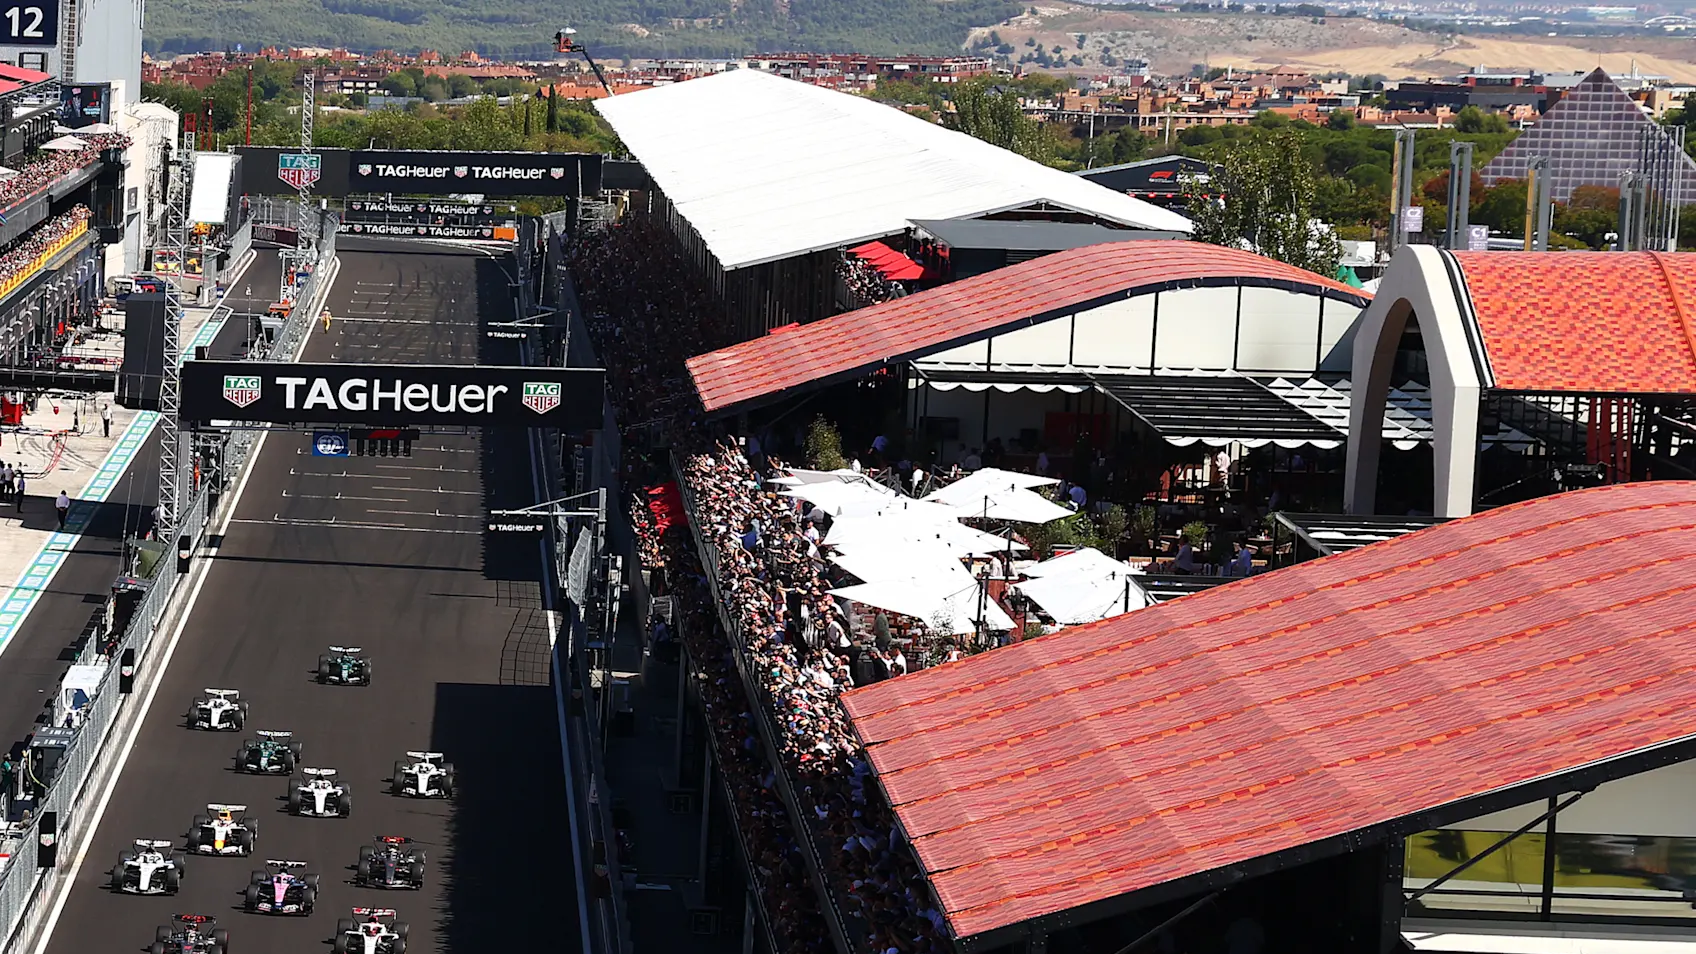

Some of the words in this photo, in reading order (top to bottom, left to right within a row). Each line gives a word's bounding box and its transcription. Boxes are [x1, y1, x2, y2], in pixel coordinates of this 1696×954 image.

[5, 7, 44, 38] 12
[376, 165, 450, 179] TAGHeuer
[472, 166, 546, 180] TAGHeuer
[1407, 209, 1421, 218] C2
[364, 225, 415, 236] TAGHeuer
[1472, 227, 1486, 238] C1
[226, 377, 258, 389] TAG
[526, 383, 559, 395] TAG
[225, 389, 260, 405] HEUER
[276, 377, 508, 413] TAGHeuer
[524, 396, 561, 412] HEUER
[497, 524, 535, 532] TAGHeuer
